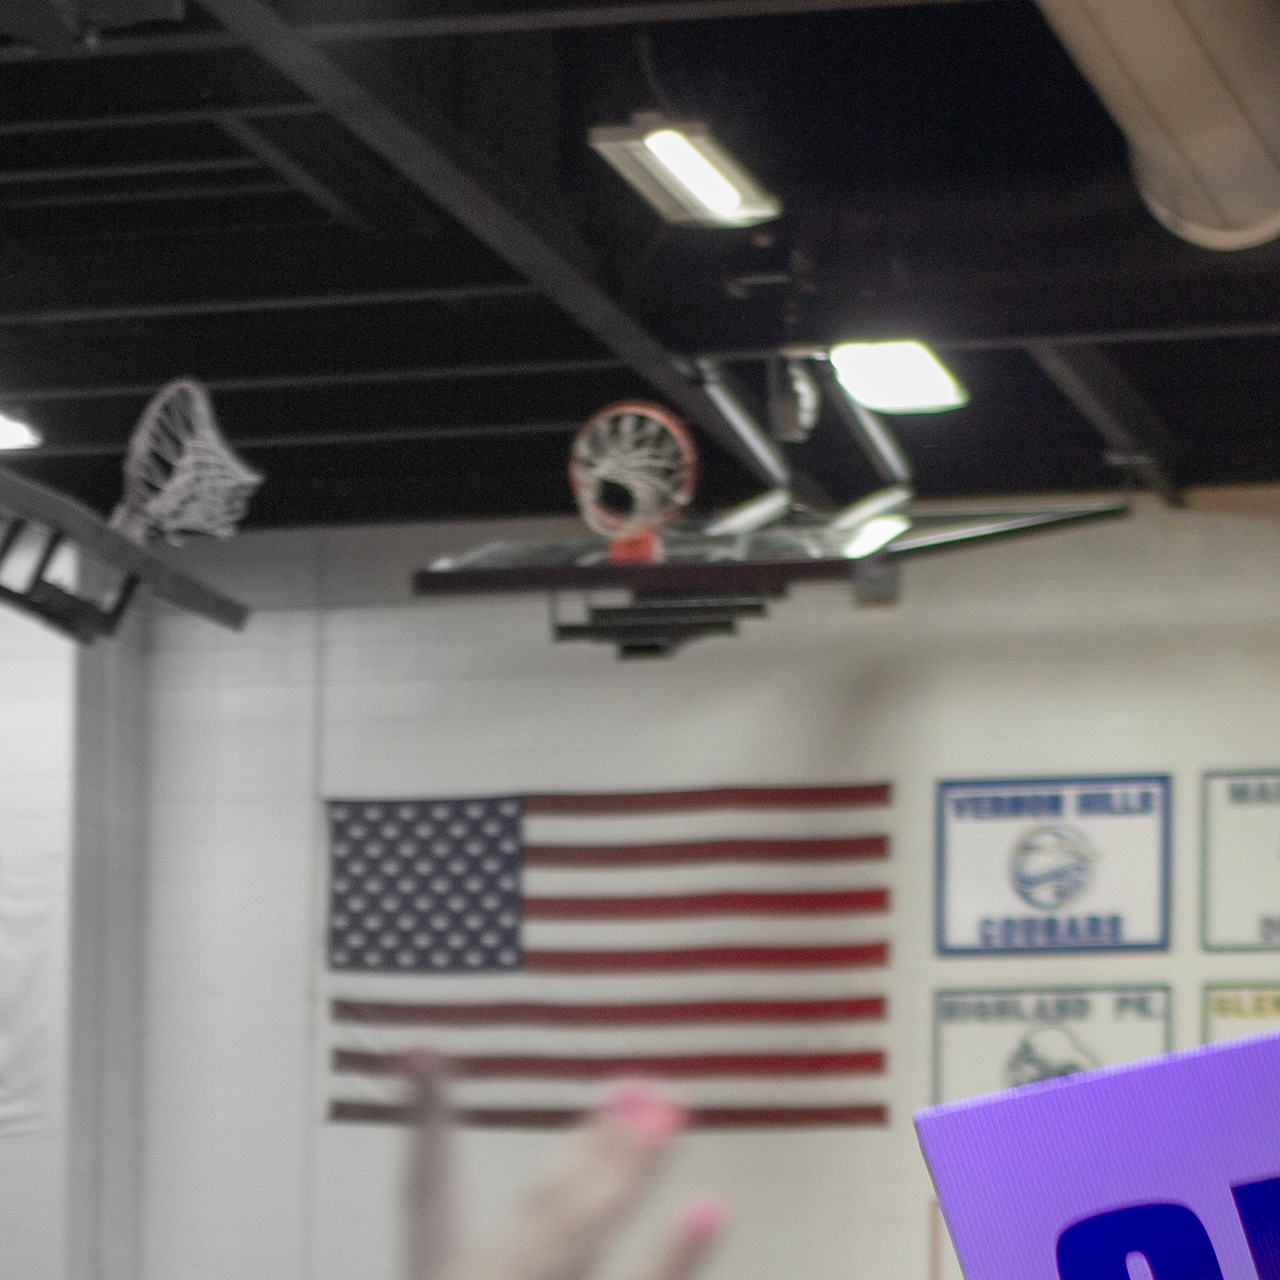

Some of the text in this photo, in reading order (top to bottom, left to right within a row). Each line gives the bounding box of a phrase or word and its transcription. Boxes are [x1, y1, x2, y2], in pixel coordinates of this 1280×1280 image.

[952, 791, 1154, 820] VERNON HILLS
[978, 914, 1123, 948] COUGARS
